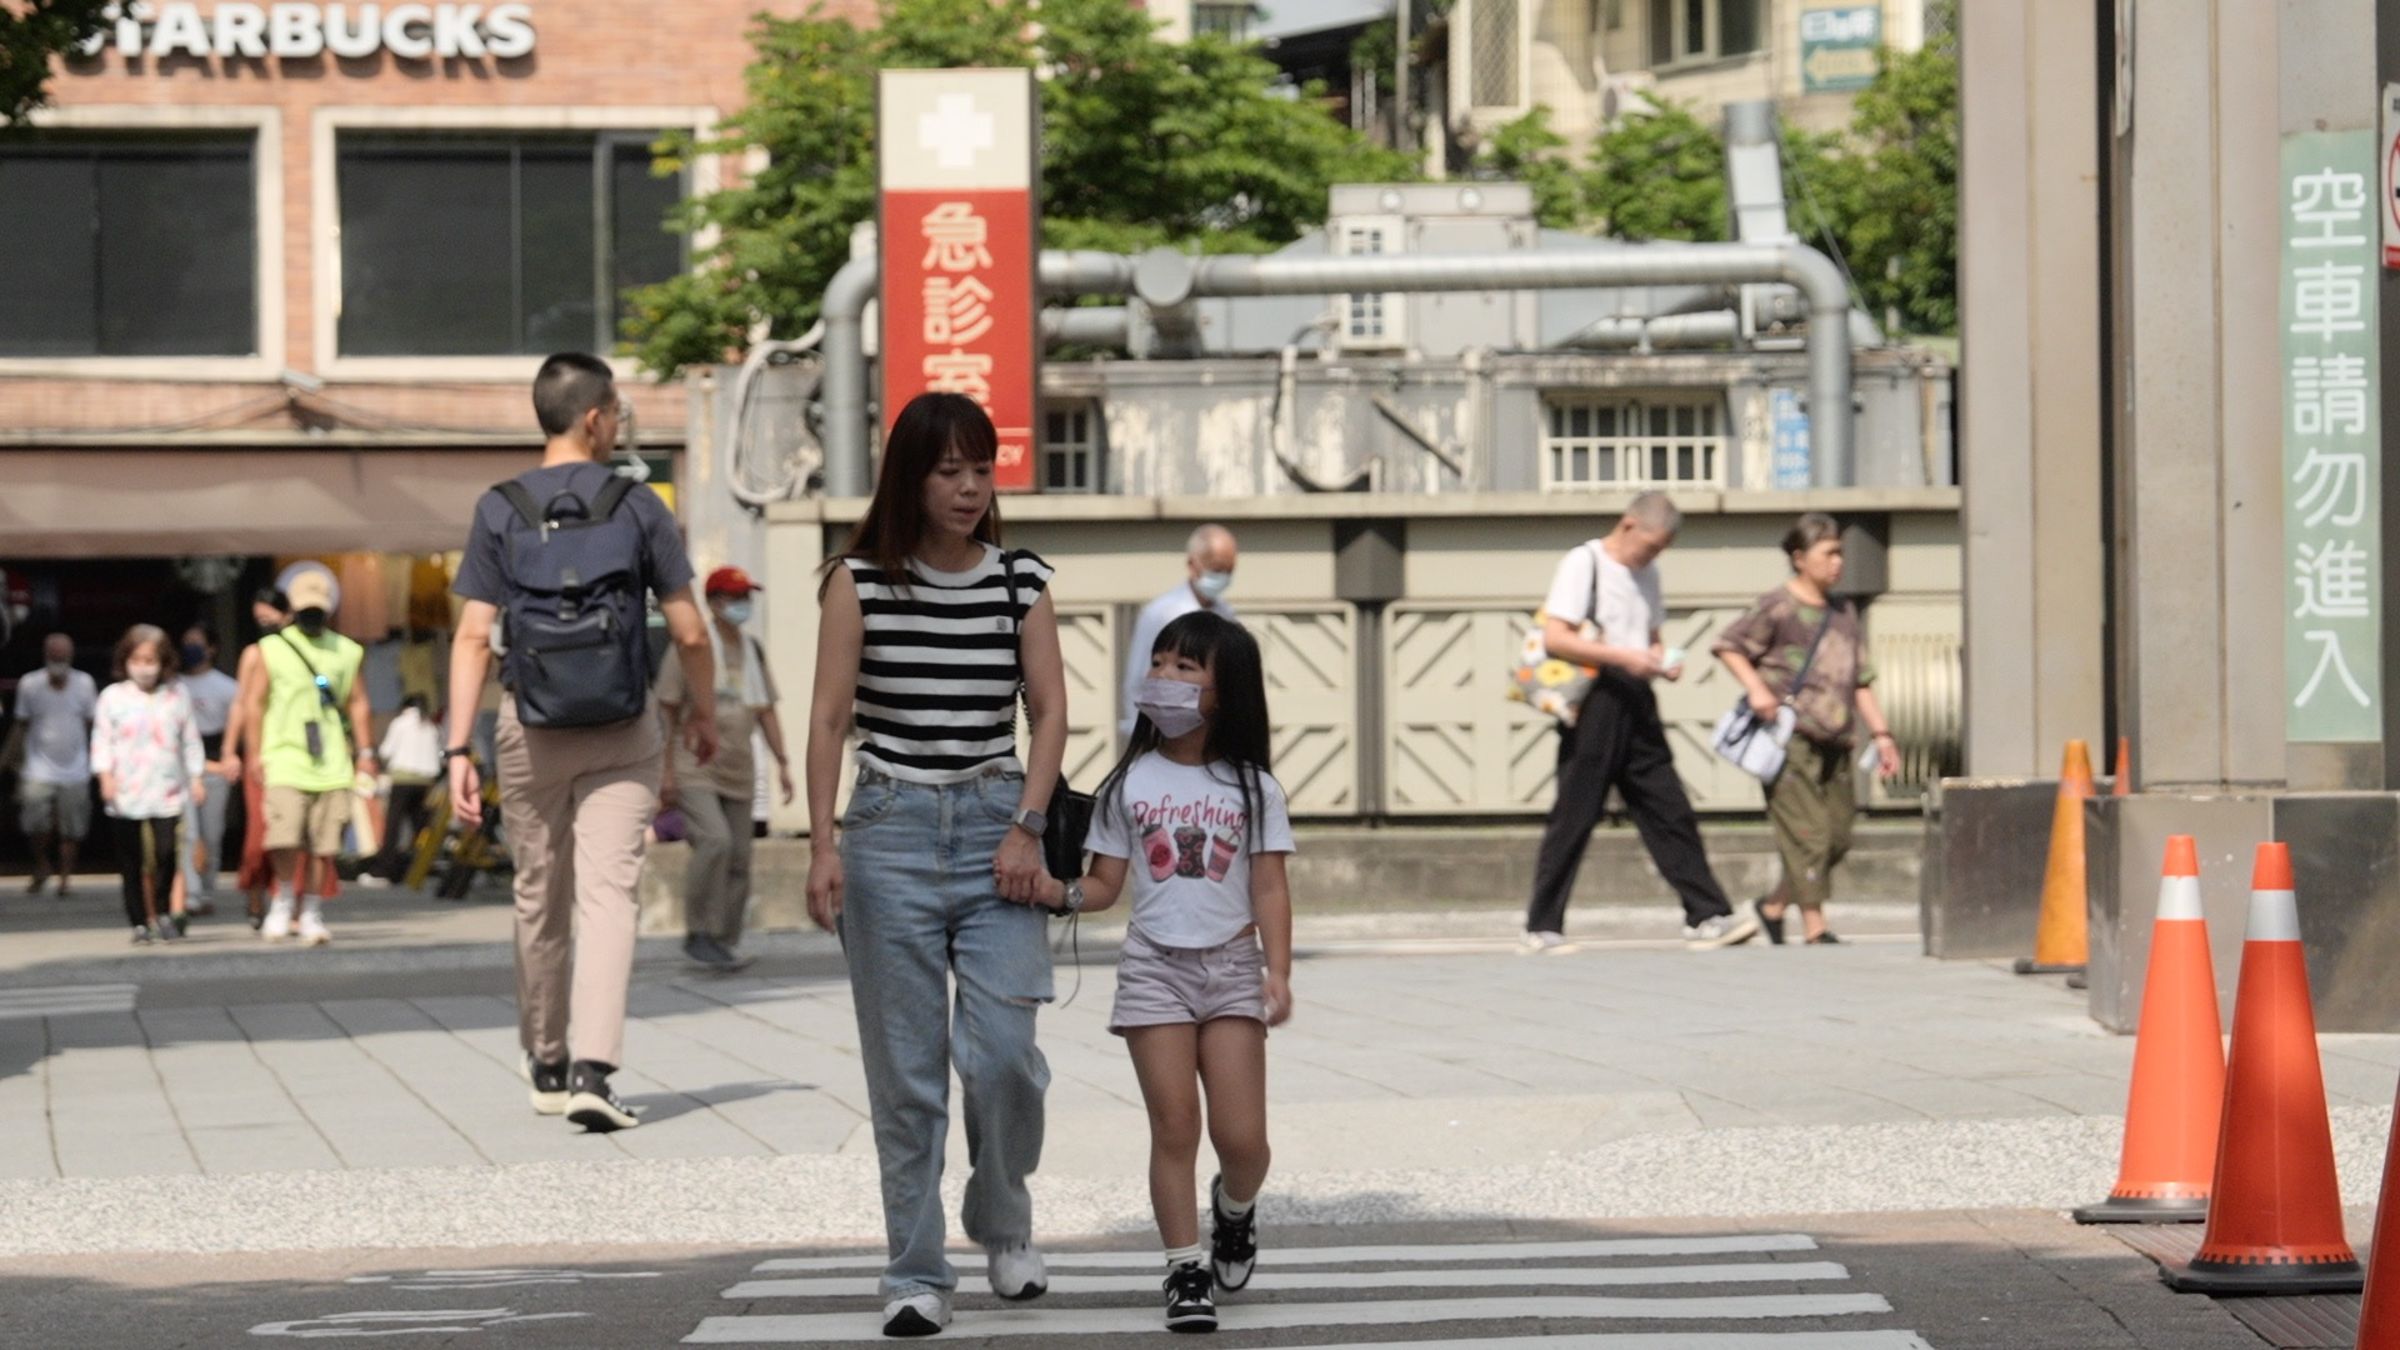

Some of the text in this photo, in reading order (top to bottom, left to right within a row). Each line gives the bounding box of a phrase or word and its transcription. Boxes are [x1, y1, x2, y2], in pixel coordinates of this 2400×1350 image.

[76, 2, 536, 57] TARBUCKS
[2290, 166, 2371, 708] 空車請勿進入
[1133, 794, 1248, 832] Refreshing
